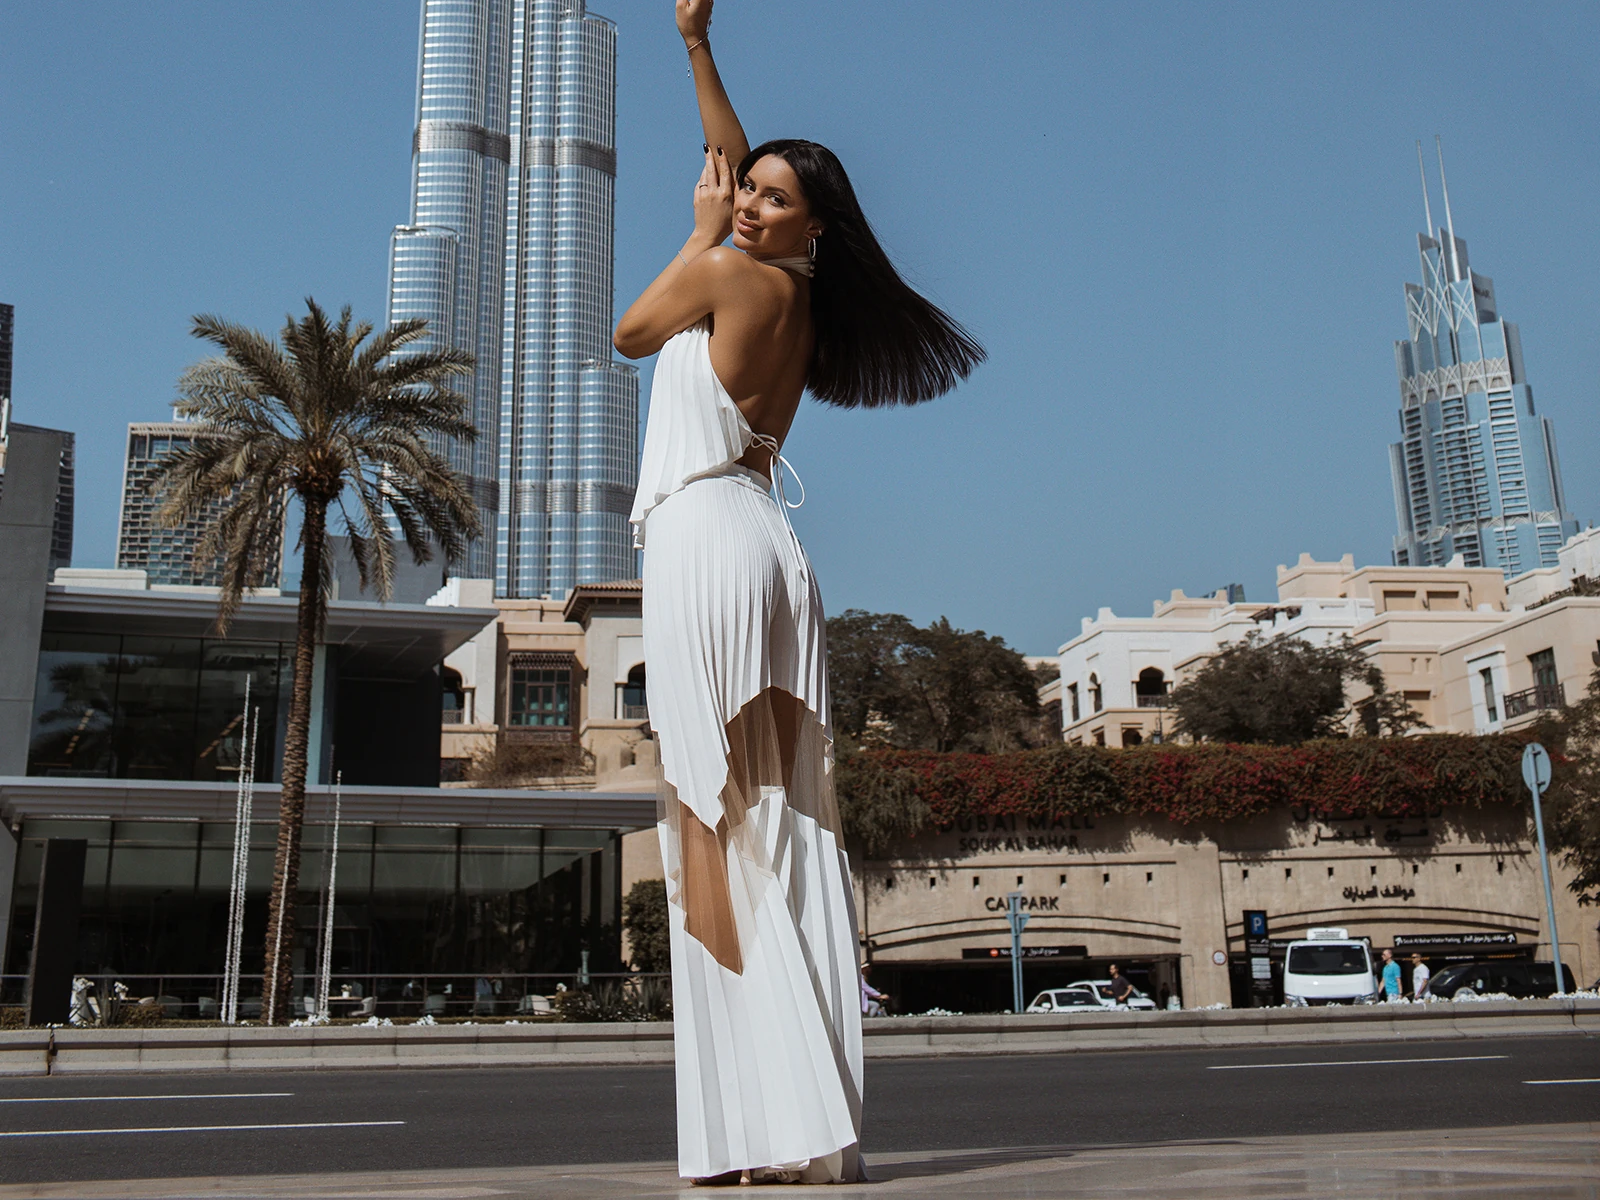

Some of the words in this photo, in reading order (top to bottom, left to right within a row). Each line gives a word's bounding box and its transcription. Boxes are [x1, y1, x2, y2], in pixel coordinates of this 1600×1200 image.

[1028, 812, 1095, 831] MALL
[959, 837, 1001, 852] SOUK
[1005, 837, 1024, 851] AL
[1027, 835, 1079, 850] BAHAR
[985, 896, 1012, 912] CA
[1020, 896, 1059, 911] PARK
[1253, 917, 1262, 931] P
